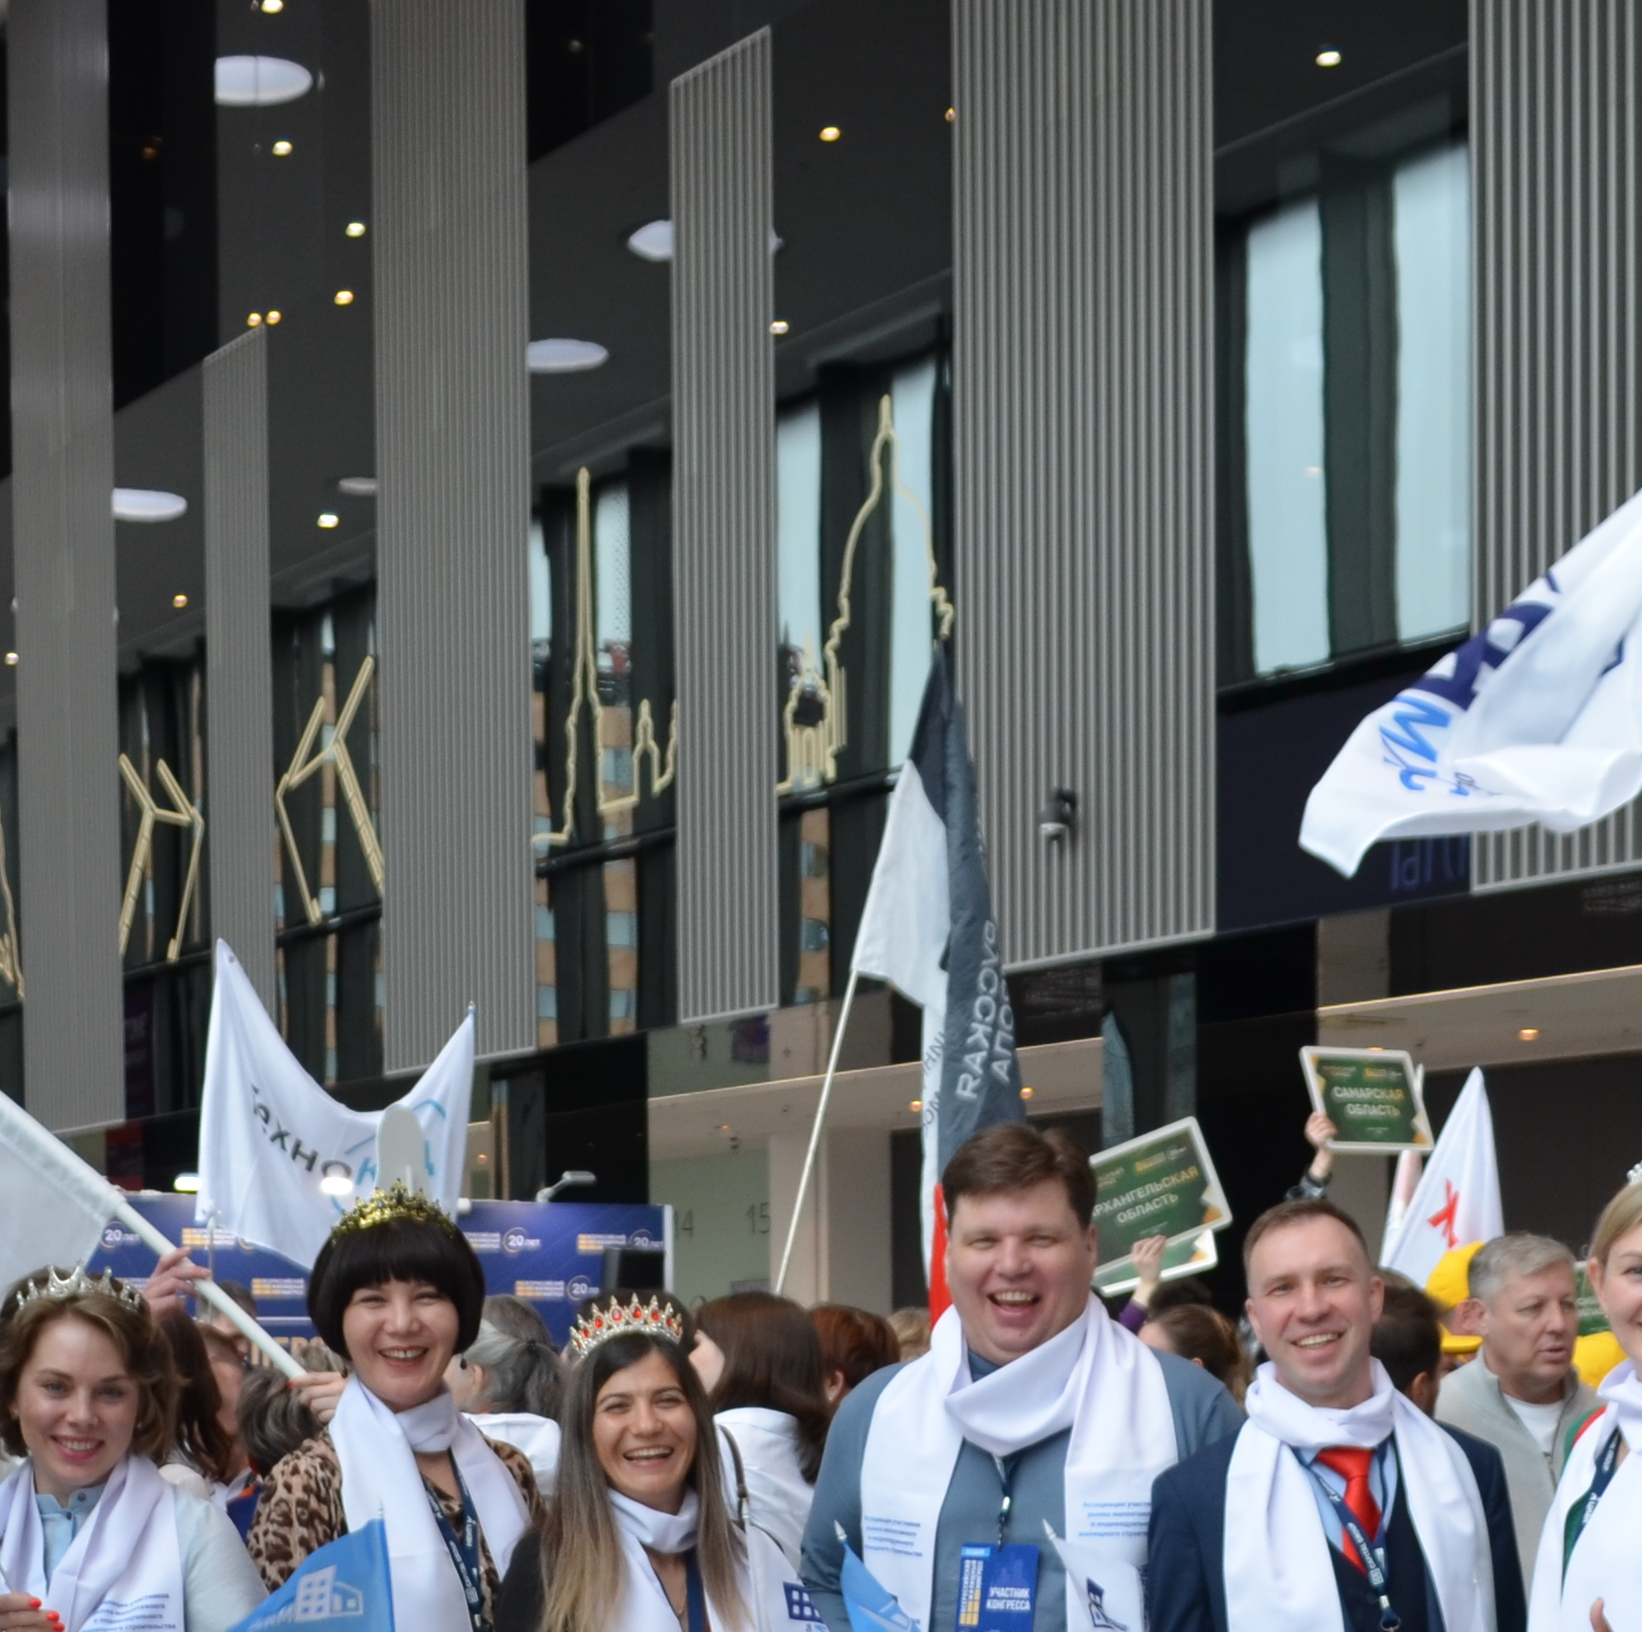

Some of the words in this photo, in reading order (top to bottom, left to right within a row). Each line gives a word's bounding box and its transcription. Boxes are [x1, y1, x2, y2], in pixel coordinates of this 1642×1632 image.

[1333, 1085, 1405, 1100] САМАРСКАЯ
[1347, 1103, 1401, 1116] ОБЛАСТЬ
[1117, 1192, 1179, 1223] ОБЛАСТЬ
[508, 1235, 524, 1247] 20
[572, 1283, 588, 1295] 20
[989, 1586, 1031, 1599] УЧАСТНИК
[985, 1599, 1031, 1611] КОНГРЕССА
